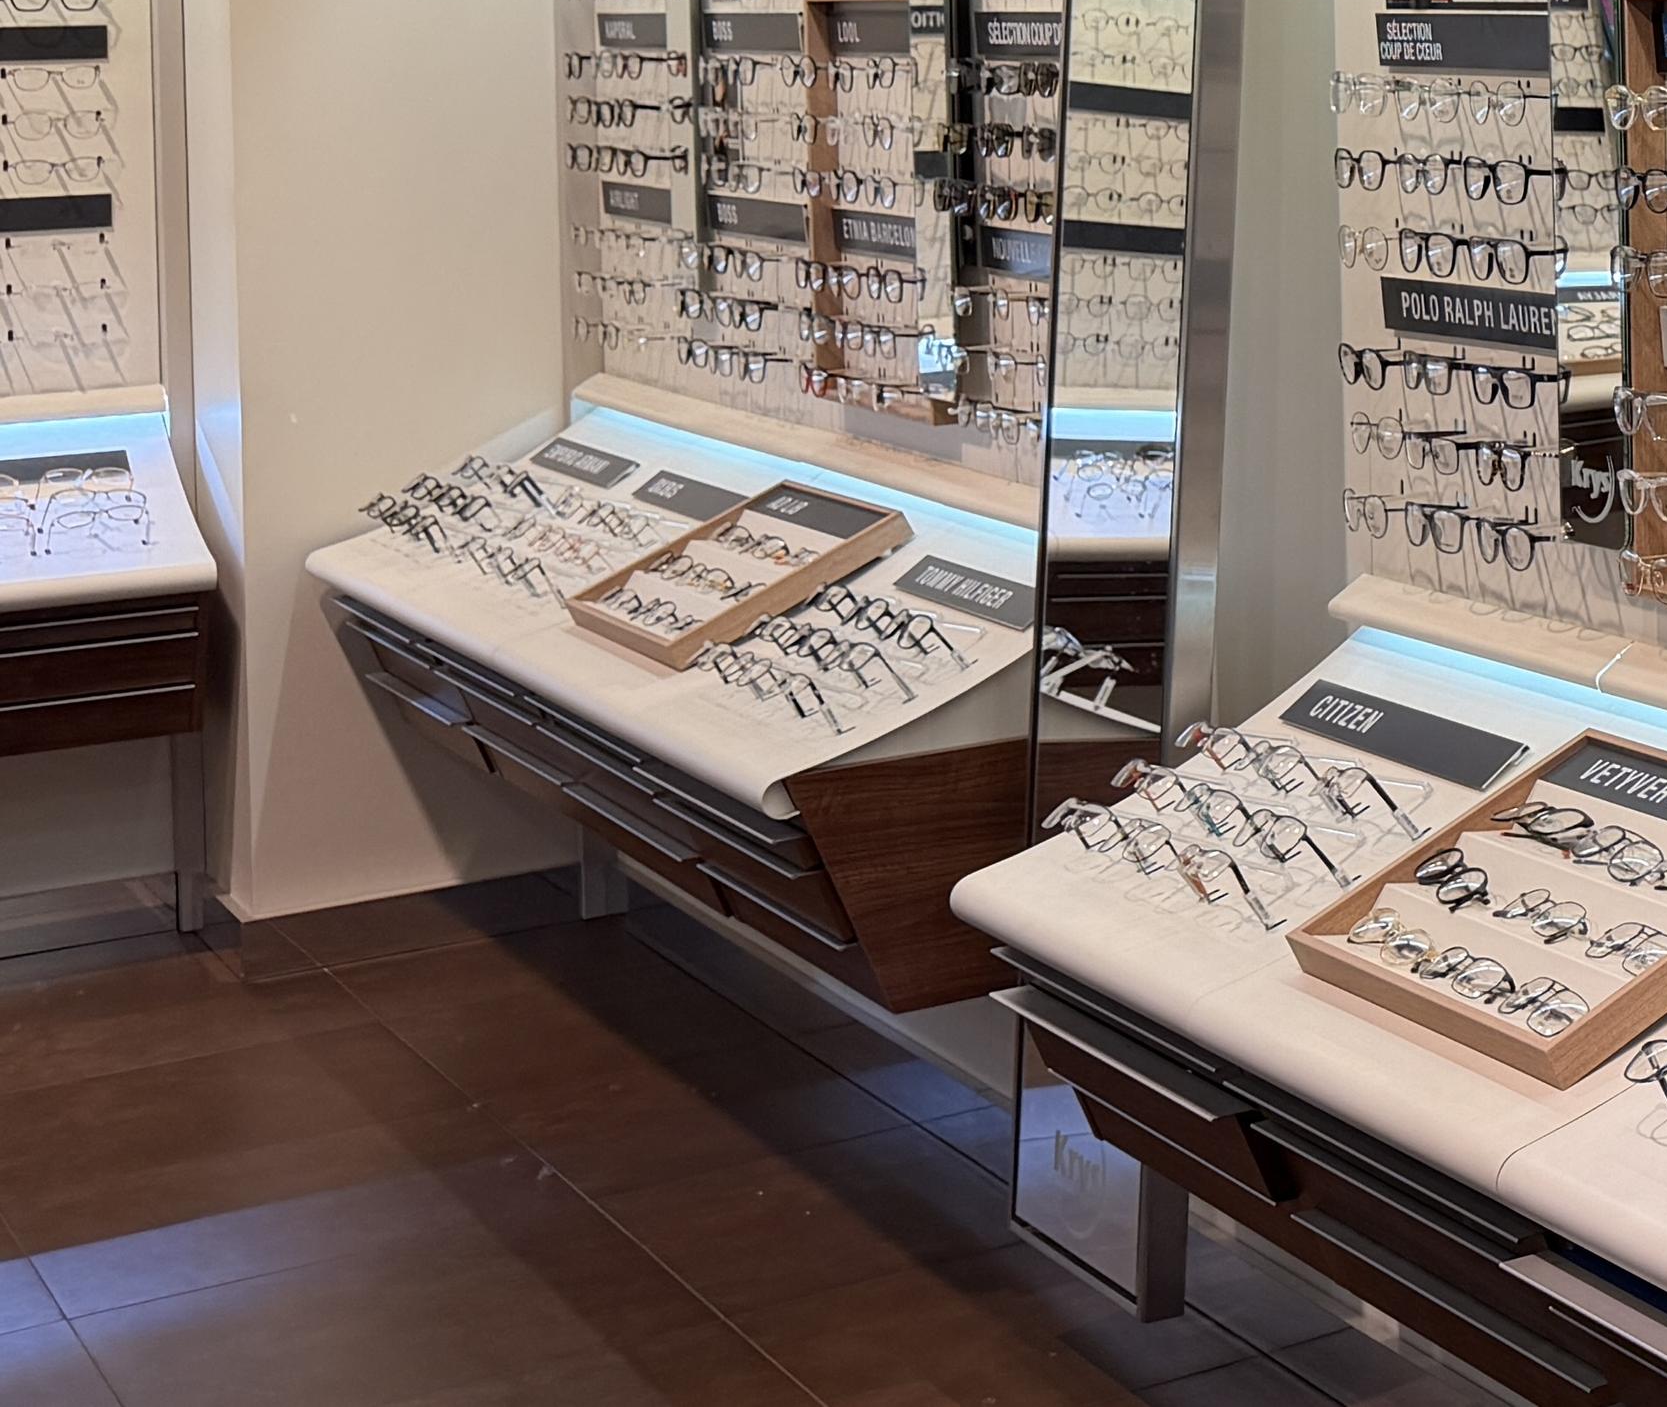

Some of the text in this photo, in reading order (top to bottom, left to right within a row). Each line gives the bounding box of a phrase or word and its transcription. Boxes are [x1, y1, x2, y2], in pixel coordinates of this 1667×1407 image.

[712, 20, 733, 41] BOSS
[988, 18, 1030, 45] SÉLECTION
[1030, 22, 1053, 46] COUP
[1386, 18, 1433, 41] SÉLECTION
[1380, 41, 1402, 60] COUP
[1403, 43, 1415, 60] DE
[717, 203, 738, 224] BOSS
[1401, 291, 1439, 323] POLO
[1444, 296, 1494, 328] RALPH
[1571, 459, 1610, 499] Krys
[915, 565, 1014, 609] TOMMY HILFIGER
[1309, 694, 1384, 735] CITIZEN
